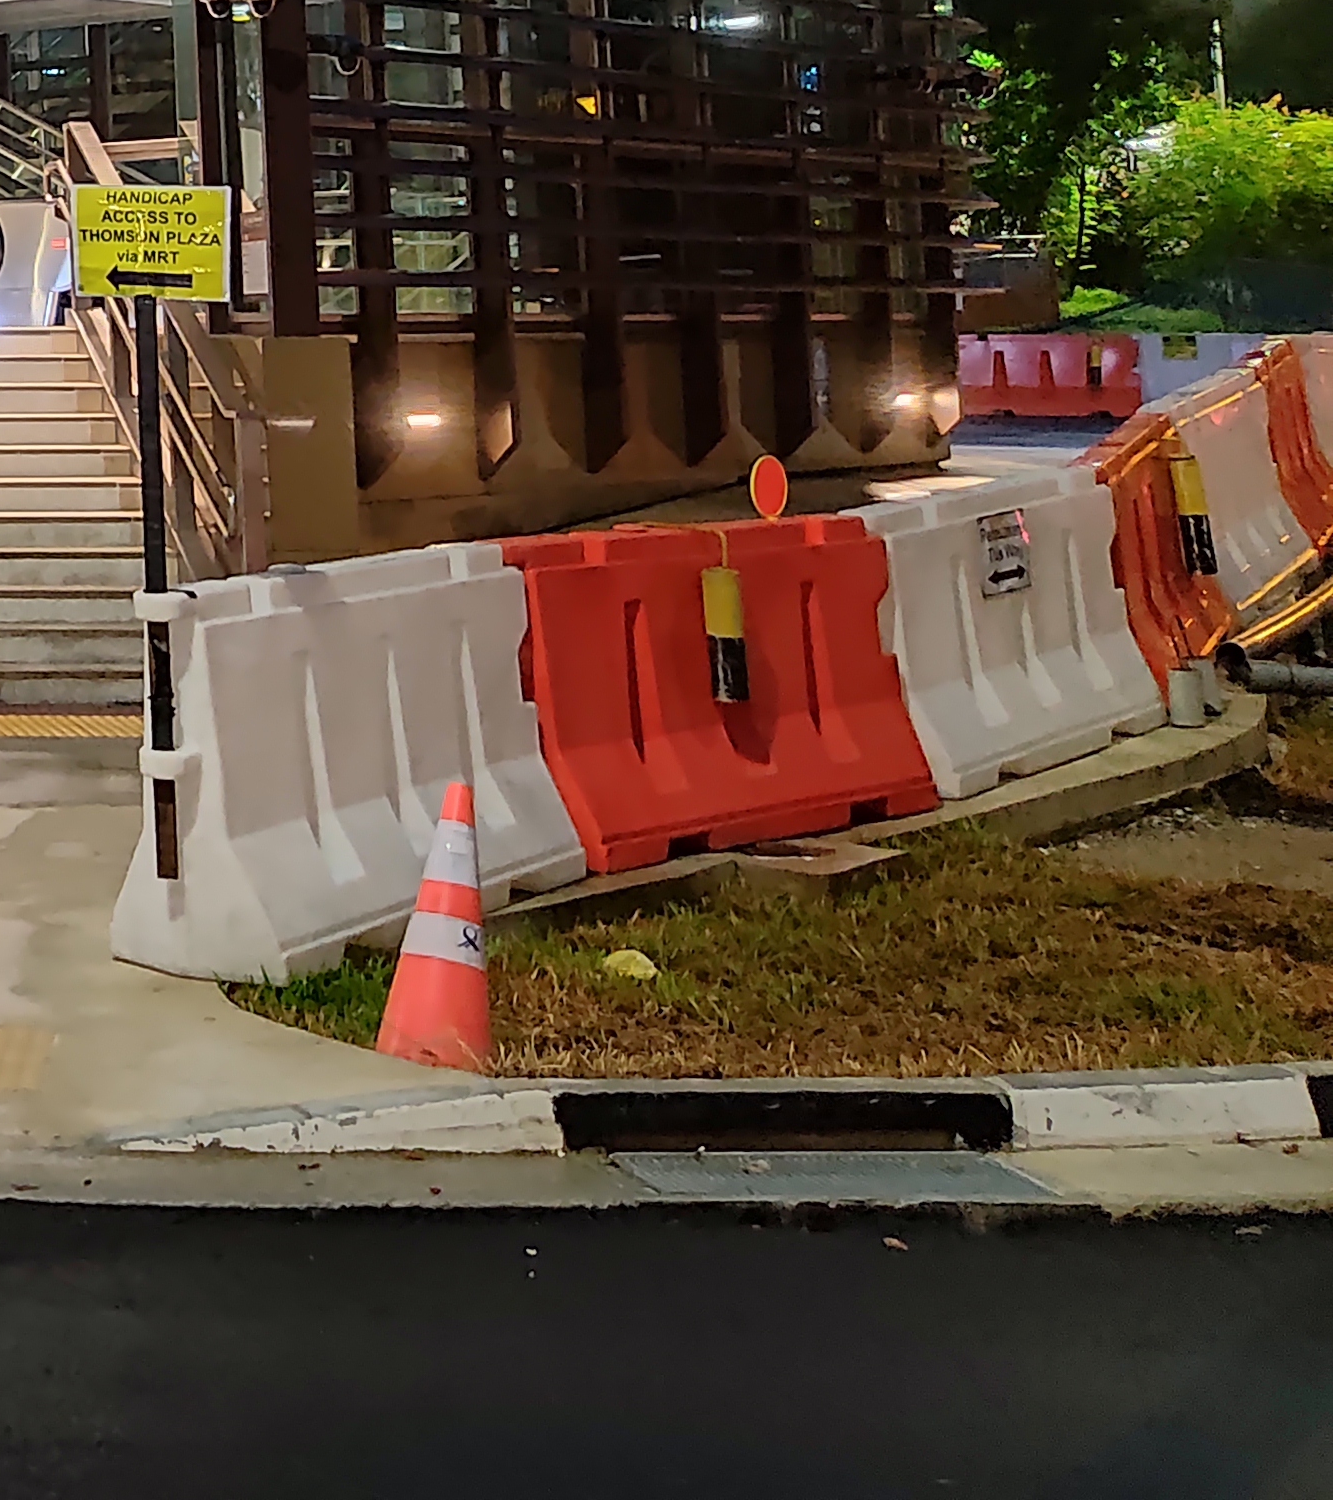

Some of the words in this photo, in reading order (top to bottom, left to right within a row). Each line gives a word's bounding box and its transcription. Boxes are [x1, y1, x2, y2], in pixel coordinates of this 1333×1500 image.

[106, 191, 193, 205] HANDICAP
[101, 211, 169, 224] ACCESS
[174, 212, 197, 225] TO
[79, 229, 160, 243] THOMSON
[166, 231, 221, 246] PLAZA
[117, 249, 138, 263] via
[143, 250, 180, 264] MRT
